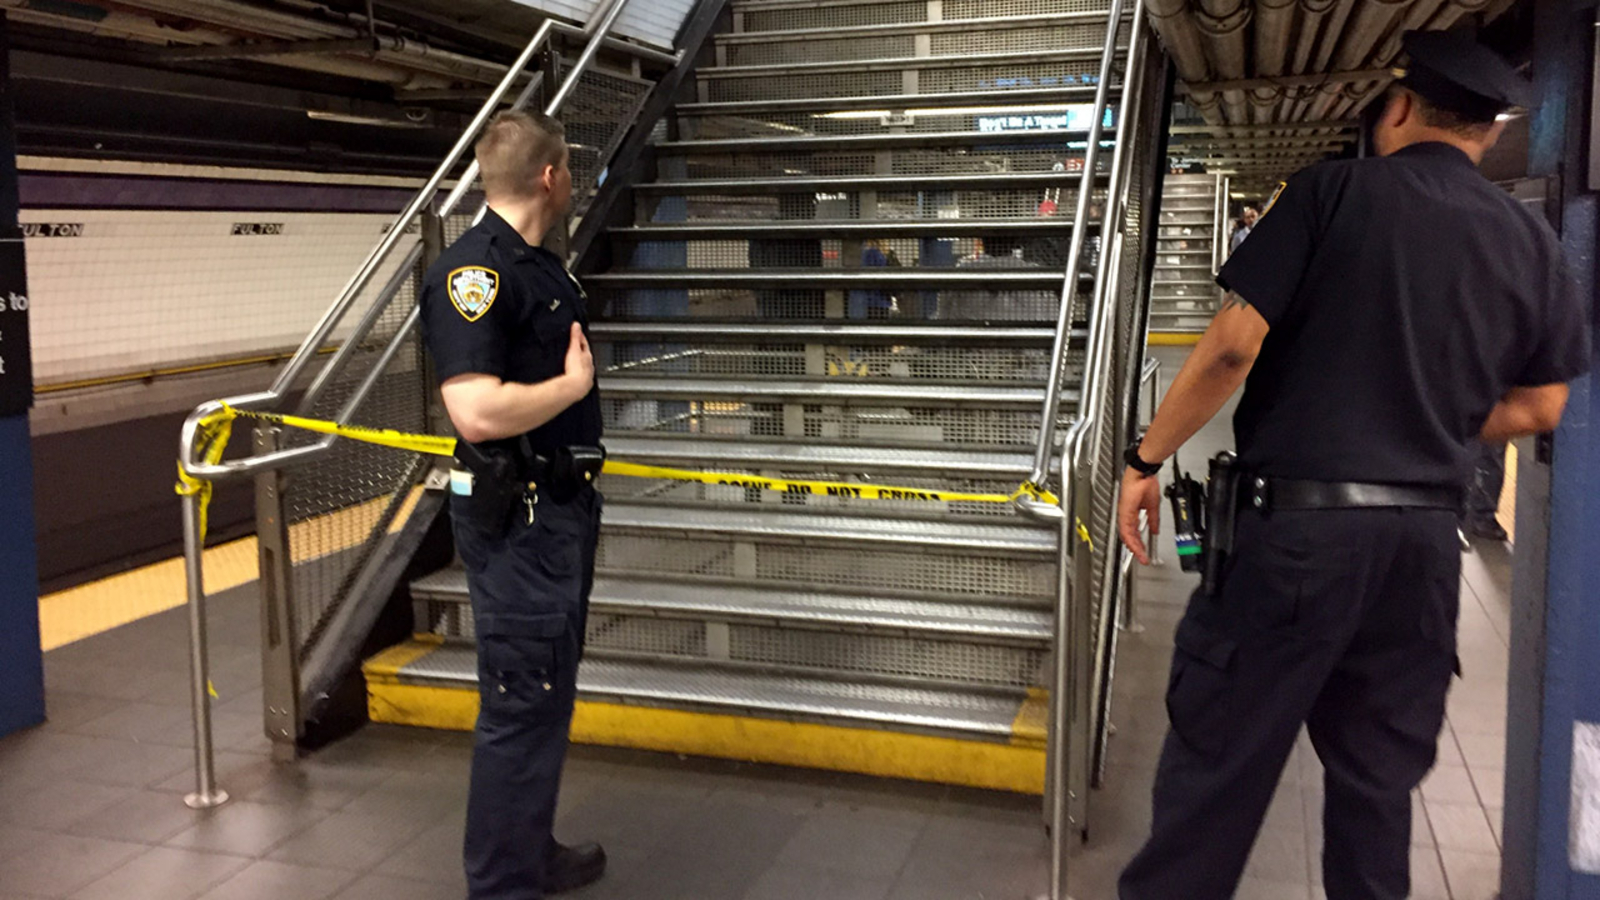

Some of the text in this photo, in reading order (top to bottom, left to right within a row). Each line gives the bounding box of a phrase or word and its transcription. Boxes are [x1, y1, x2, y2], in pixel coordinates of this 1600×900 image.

[232, 223, 284, 235] FULTON
[9, 291, 28, 311] to
[826, 486, 862, 499] NOT
